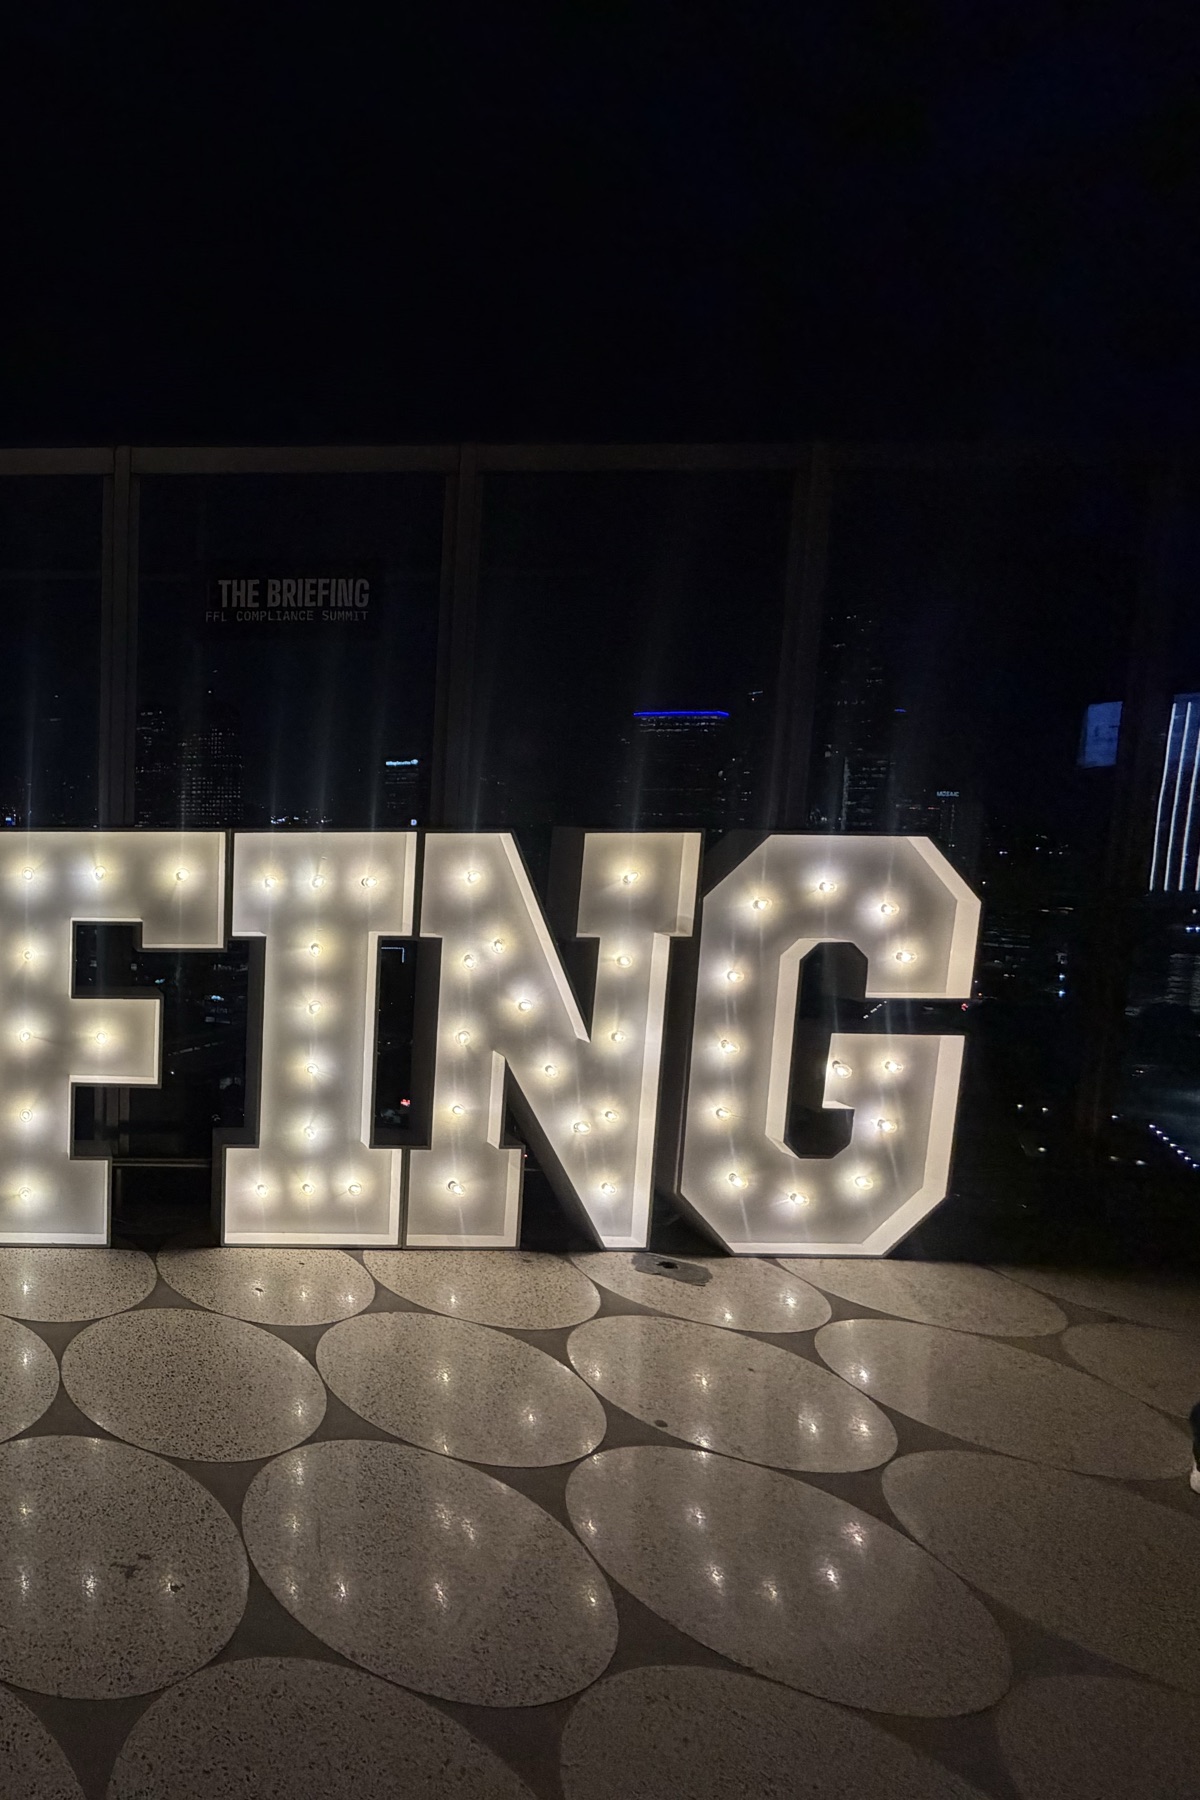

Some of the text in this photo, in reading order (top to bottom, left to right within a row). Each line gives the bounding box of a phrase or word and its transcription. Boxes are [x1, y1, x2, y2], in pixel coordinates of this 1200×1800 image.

[218, 578, 370, 608] THE BRIEFING
[205, 610, 369, 622] FFL COMPLIANCE SUMMIT
